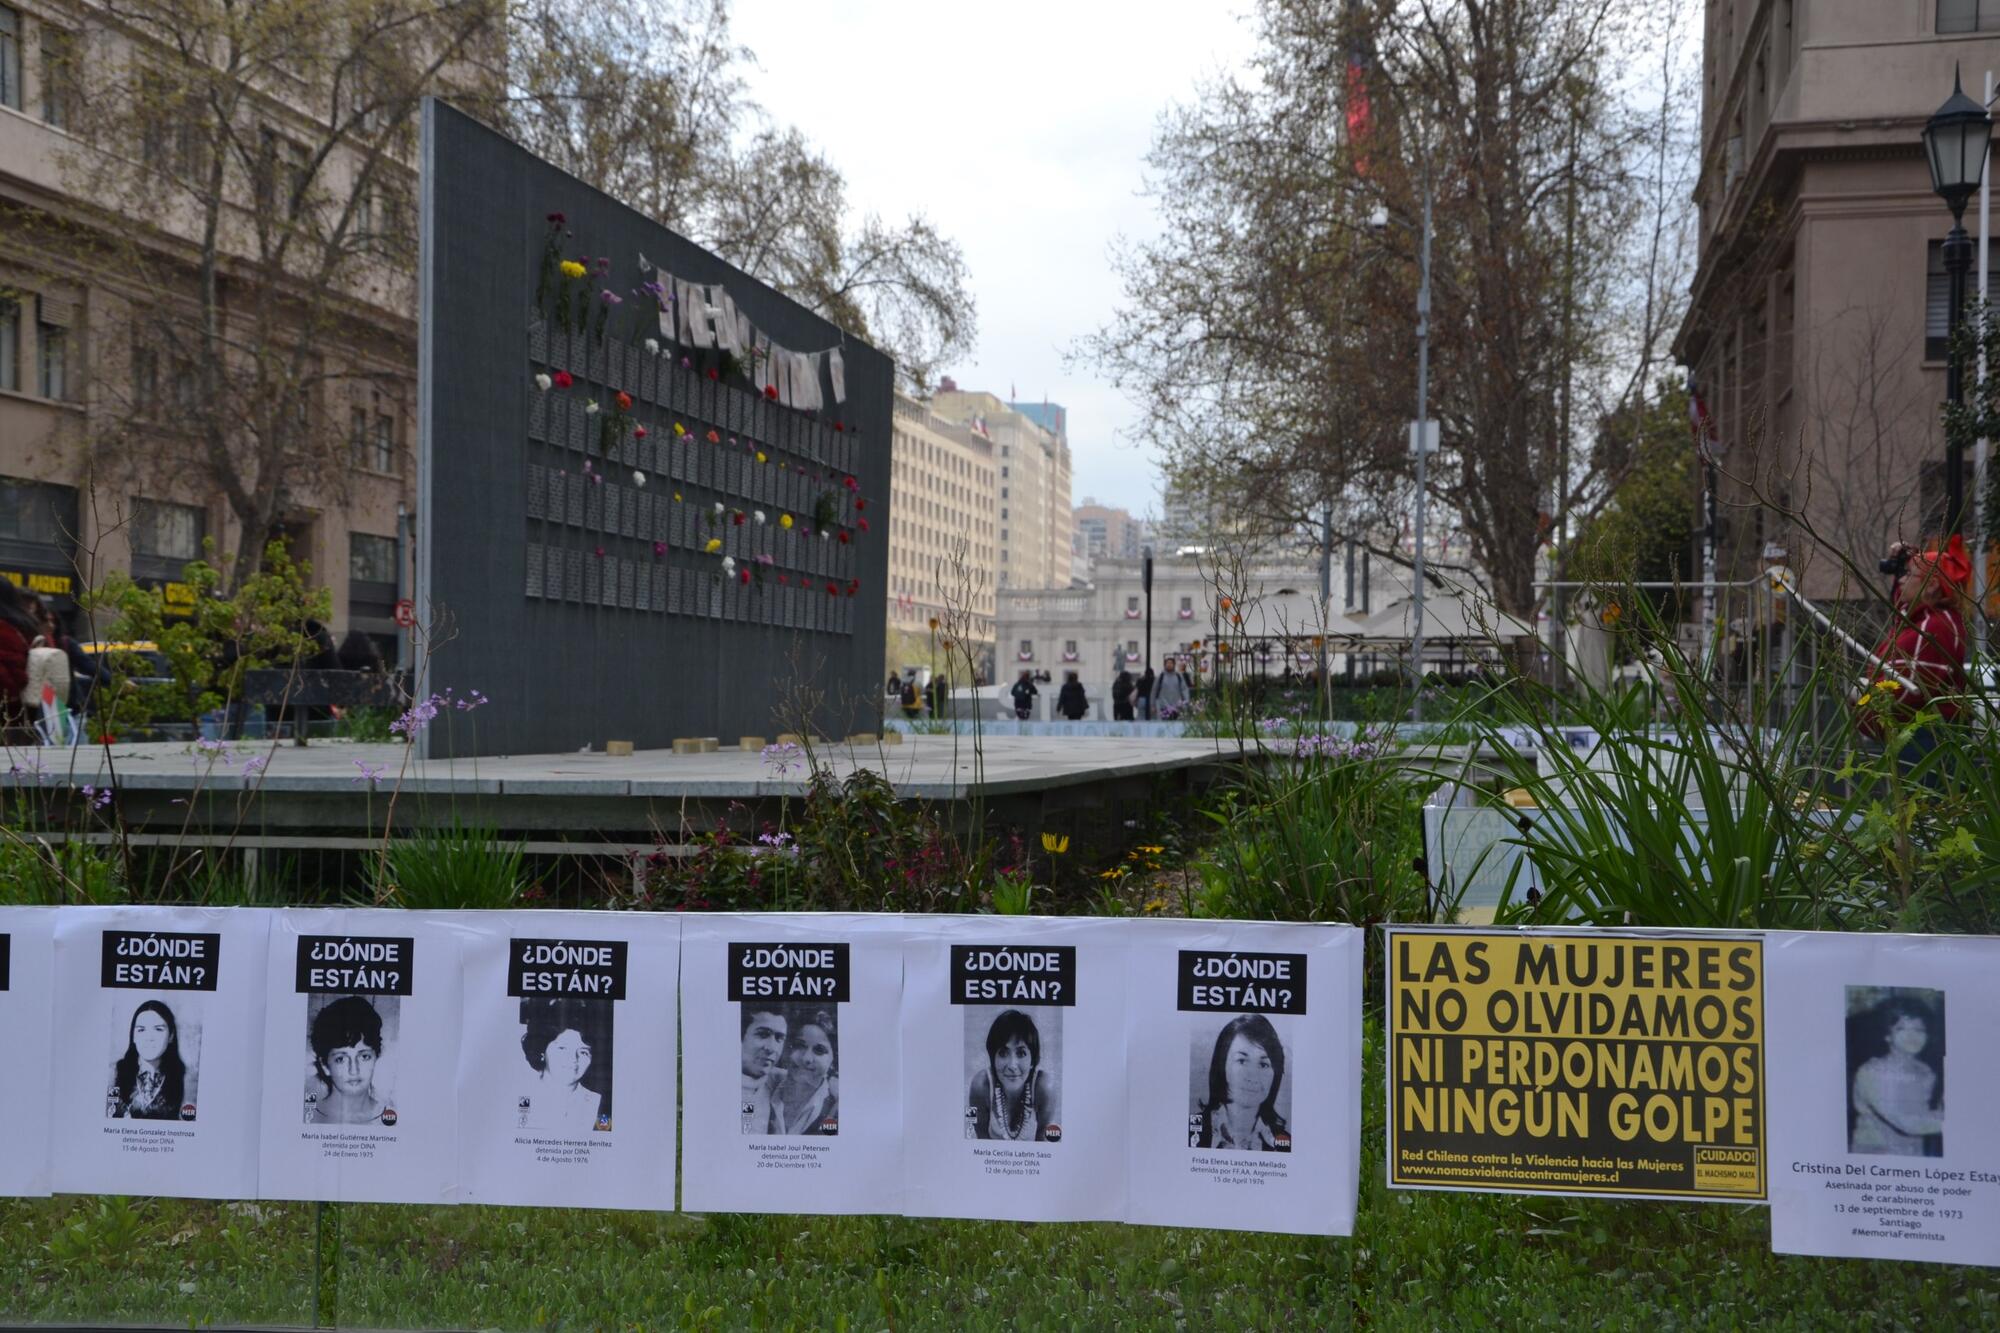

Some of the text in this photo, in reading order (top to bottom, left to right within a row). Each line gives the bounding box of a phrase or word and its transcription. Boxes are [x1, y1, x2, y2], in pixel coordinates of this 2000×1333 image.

[116, 933, 205, 958] ¿DÓNDE
[310, 938, 398, 961] ¿DÓNDE
[522, 941, 612, 966] ¿DÓNDE
[742, 944, 834, 968] ¿DÓNDE
[965, 947, 1060, 972] ¿DÓNDE
[1192, 954, 1290, 979] ¿DÓNDE
[1400, 940, 1755, 991] LAS MUJERES
[116, 962, 205, 985] ESTÁN?
[310, 965, 399, 989] ESTÁN?
[522, 969, 613, 993] ESTÁN?
[742, 972, 836, 996] ESTÁN?
[965, 975, 1062, 1000] ESTÁN?
[1192, 983, 1292, 1008] ESTÁN?
[1400, 988, 1755, 1040] NO OLVIDAMOS
[1402, 1038, 1754, 1093] NI PERDONAMOS
[1404, 1084, 1753, 1144] NINGÚN GOLPE
[1402, 1149, 1684, 1172] Red Chilena contra la Violencia hacia las Mujeres
[1697, 1150, 1755, 1163] ¡CUIDADO!
[1402, 1164, 1619, 1184] www.nomasviolenciacontramujeres.cl
[1792, 1161, 1841, 1175] Cristina
[1846, 1165, 1866, 1176] Del
[1870, 1165, 1920, 1178] Carmen
[1825, 1181, 1972, 1197] Asesinada por abuso de poder
[1861, 1194, 1935, 1206] de carabineros
[1834, 1204, 1963, 1219] 13 de septiembre de 1973
[1880, 1218, 1922, 1229] Santiago
[1852, 1228, 1945, 1241] #MemoriaFeminista
